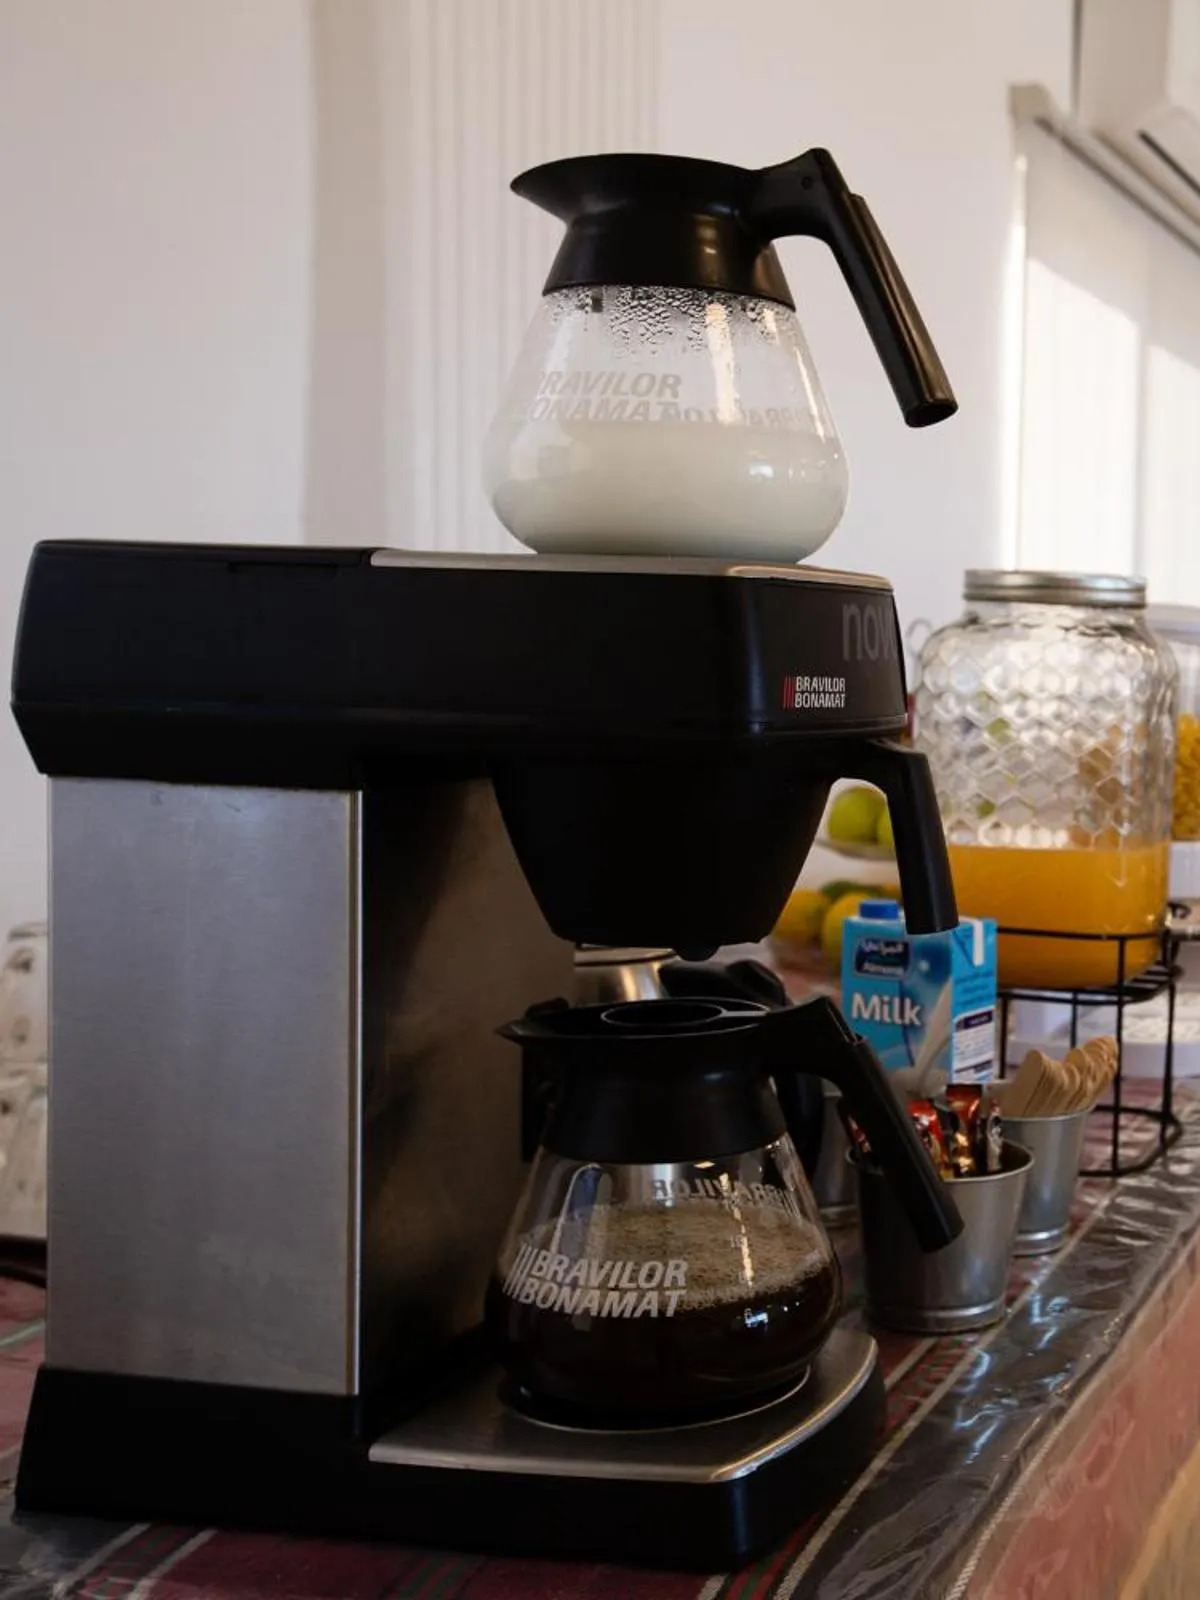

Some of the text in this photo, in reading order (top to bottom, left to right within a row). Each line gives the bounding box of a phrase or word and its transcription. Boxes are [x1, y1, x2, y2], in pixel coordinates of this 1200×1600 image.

[538, 370, 682, 399] RAVILOR
[842, 603, 898, 661] nov
[794, 692, 846, 708] BONAMAT
[795, 676, 846, 692] BRAVILOR
[851, 992, 922, 1026] Milk
[530, 1251, 689, 1289] BRAVILOR
[518, 1279, 688, 1318] BONAMAT
